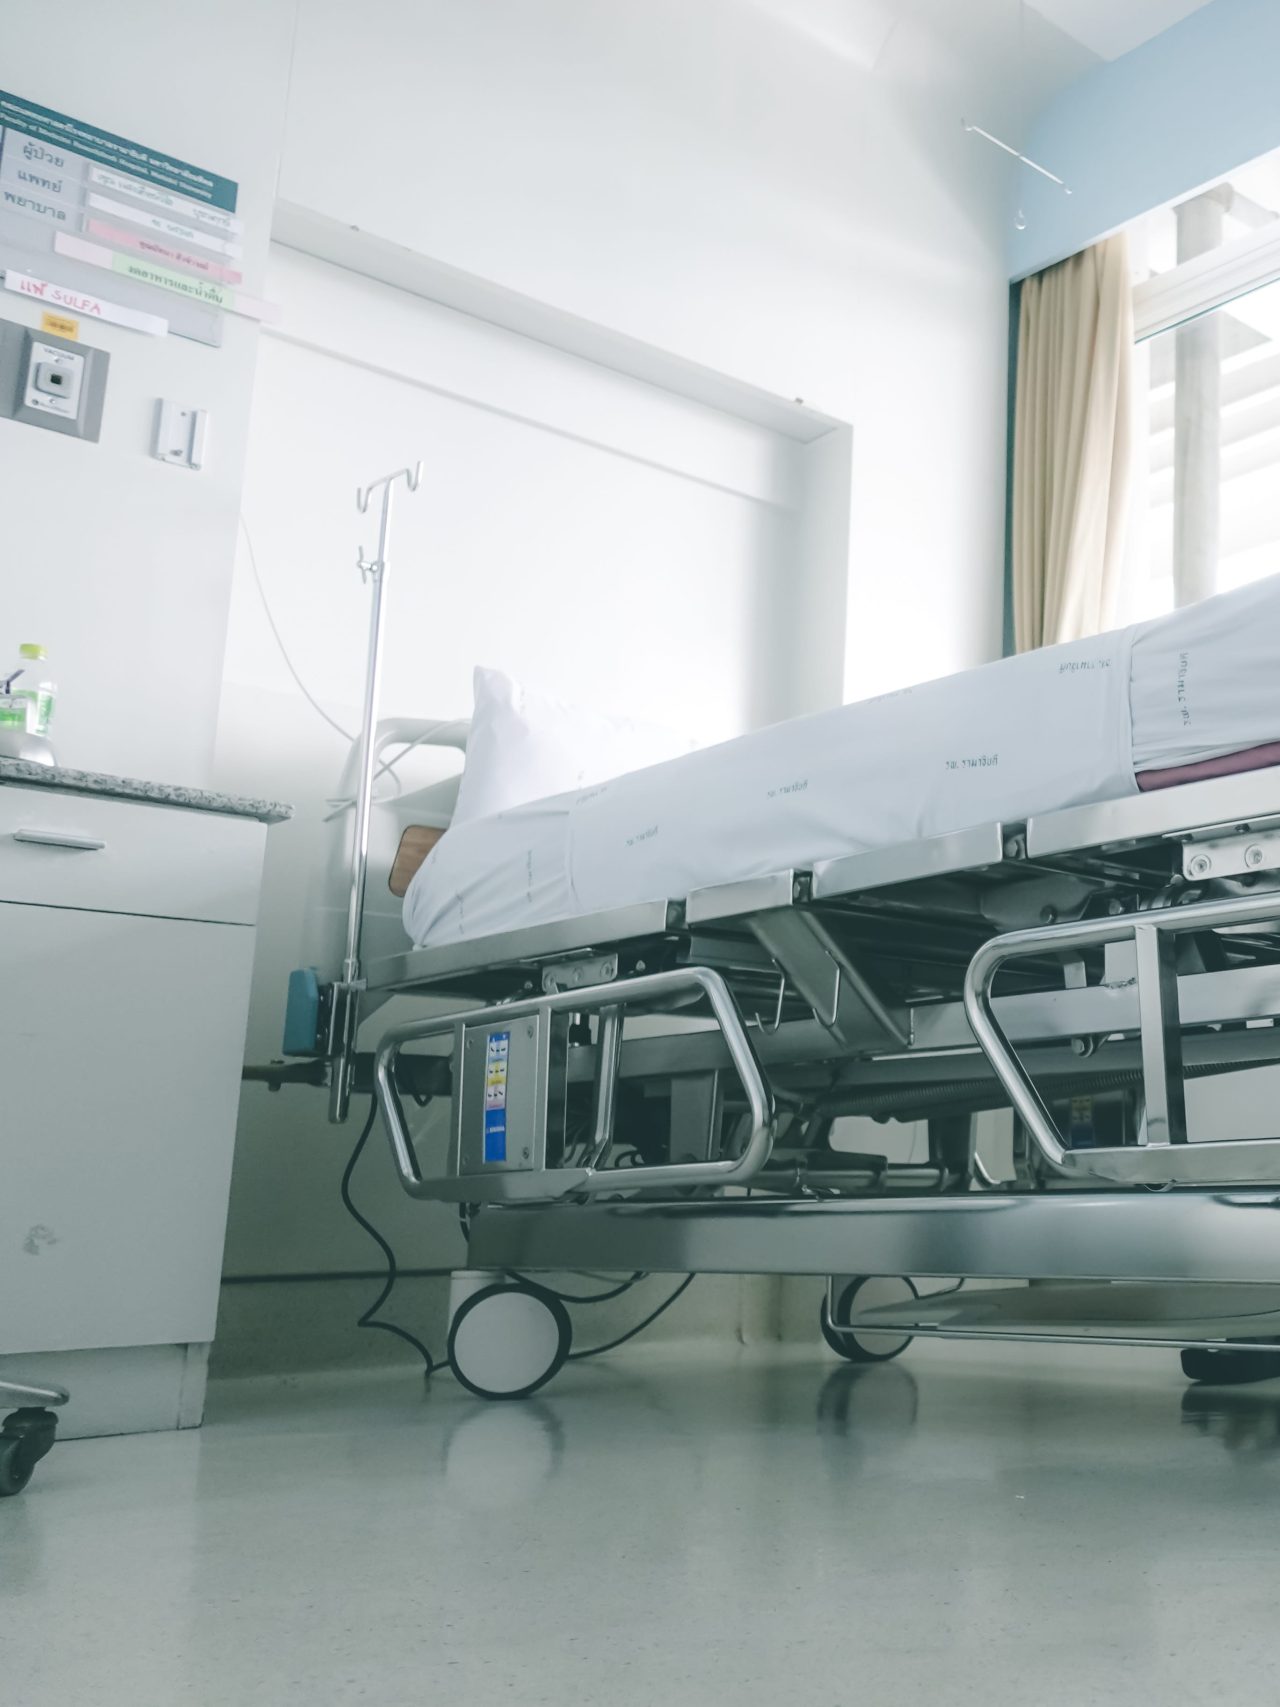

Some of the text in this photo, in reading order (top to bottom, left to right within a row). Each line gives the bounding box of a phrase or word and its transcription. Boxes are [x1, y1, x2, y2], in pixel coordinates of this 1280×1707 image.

[17, 170, 62, 193] แพทย์
[4, 191, 66, 221] พยาบาล
[51, 289, 102, 315] SULFA
